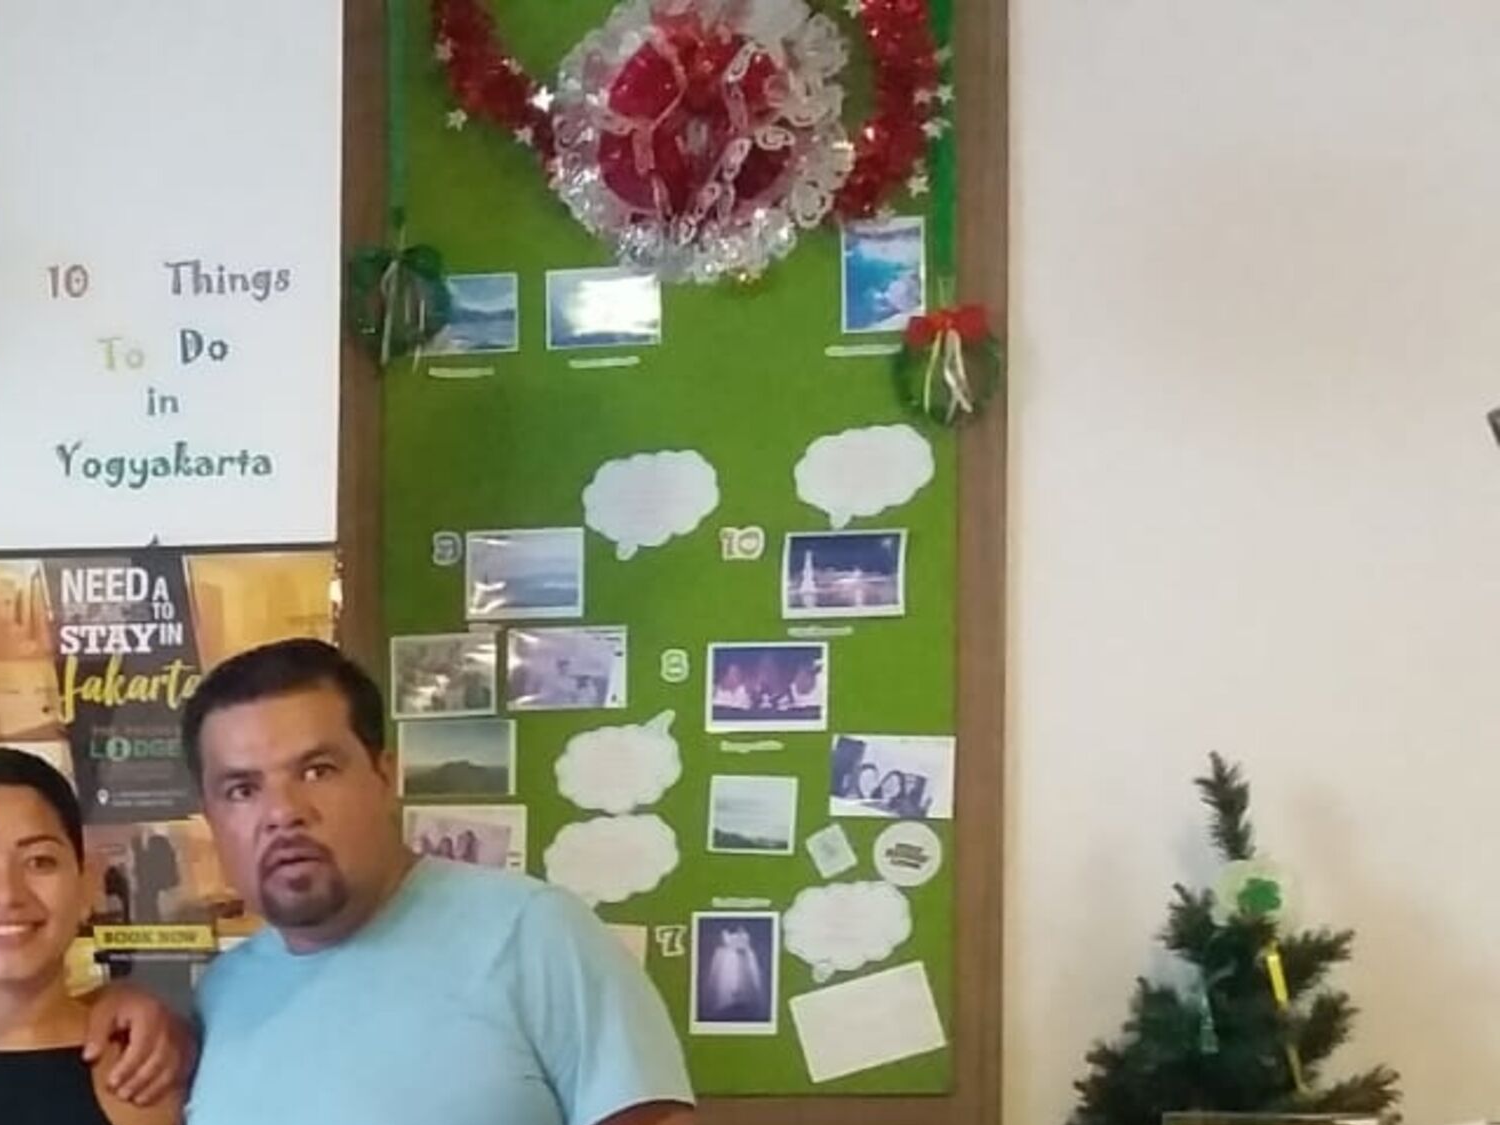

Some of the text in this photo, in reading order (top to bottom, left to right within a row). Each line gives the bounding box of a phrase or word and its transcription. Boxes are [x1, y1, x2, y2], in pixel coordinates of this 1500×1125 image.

[48, 260, 291, 301] 10 Things
[98, 328, 229, 371] To Do
[147, 387, 180, 416] in
[56, 441, 273, 489] Yogyakarta
[719, 525, 766, 560] 10
[60, 567, 169, 603] NEED A
[152, 601, 175, 619] TO
[59, 622, 183, 654] STAY IN
[104, 930, 151, 944] BOOK
[655, 924, 688, 957] 7
